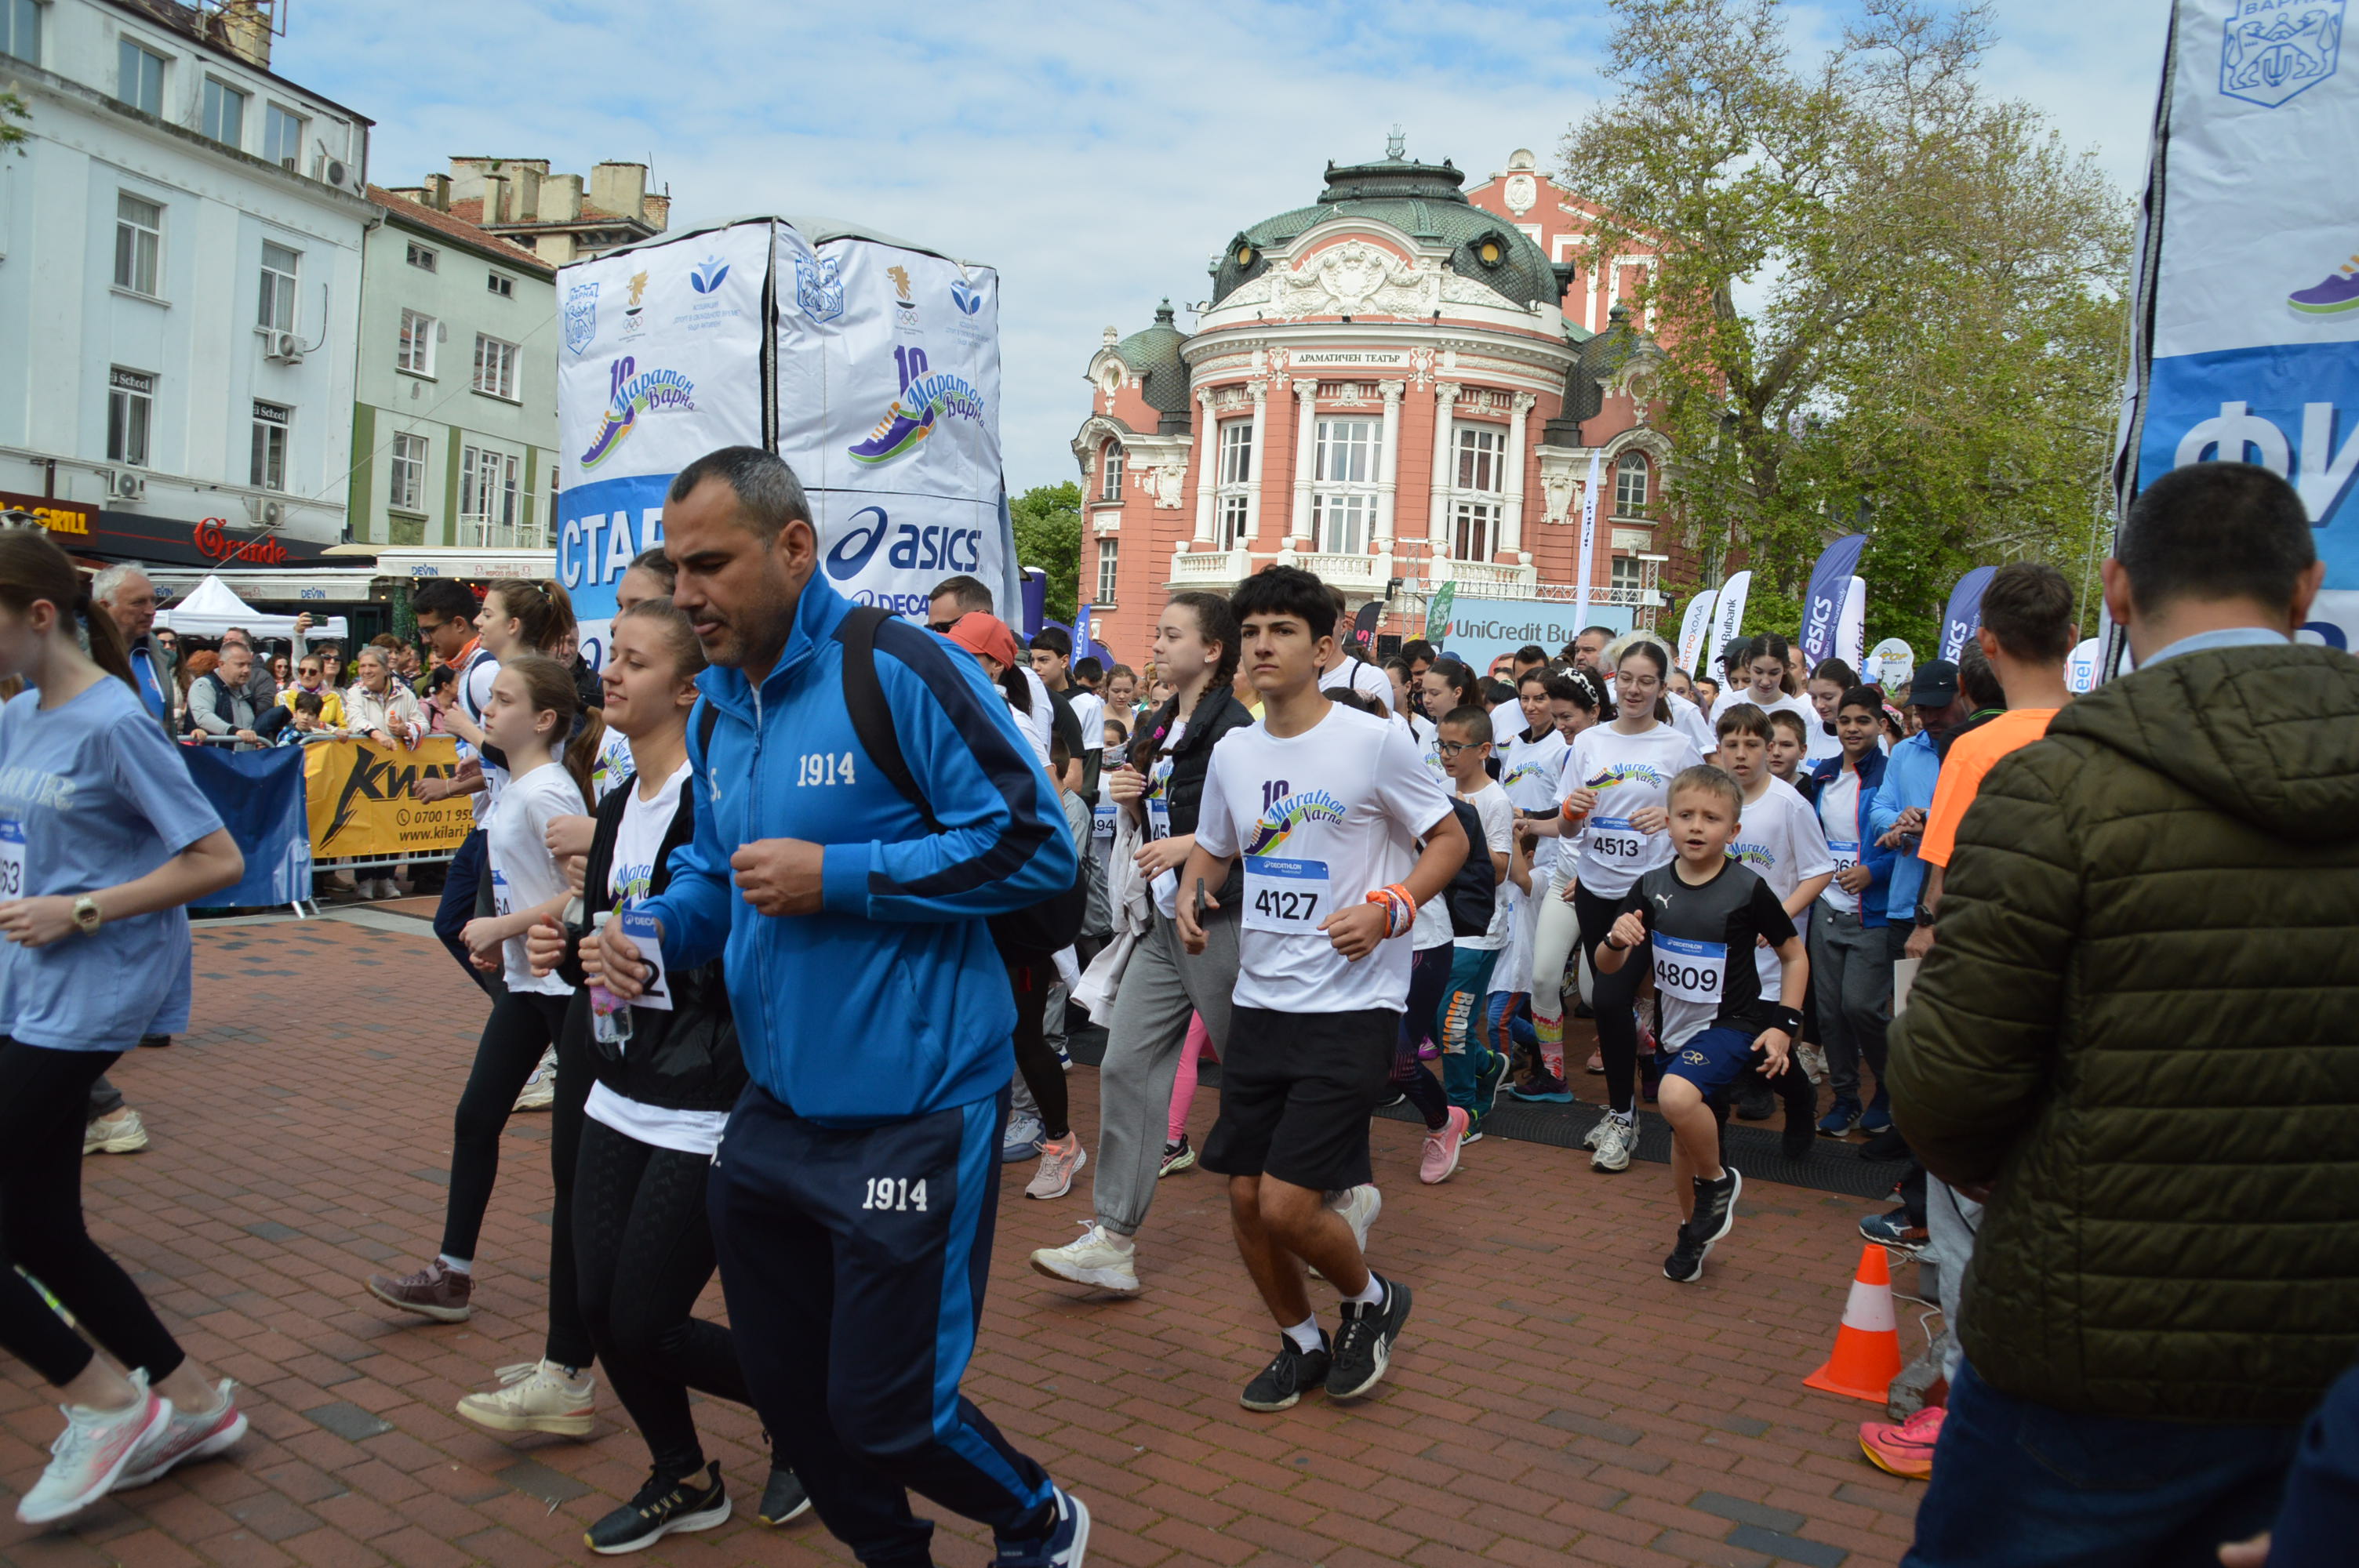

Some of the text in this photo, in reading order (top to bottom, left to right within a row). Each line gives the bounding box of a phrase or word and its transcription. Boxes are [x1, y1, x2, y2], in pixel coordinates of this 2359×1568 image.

[571, 290, 595, 302] ВАРНА
[894, 344, 929, 400] 10
[1298, 354, 1401, 363] ДРАМАТИЧЕН ТЕАТЪР
[610, 355, 635, 406] 10
[614, 368, 695, 418] Маратон
[907, 374, 985, 417] Маратон
[645, 386, 696, 411] Варна
[943, 391, 985, 428] Варна
[32, 506, 89, 535] GRILL
[194, 517, 288, 565] Grande
[412, 564, 438, 576] DEVIN
[301, 586, 325, 600] DEVIN
[1456, 619, 1543, 643] UniCredit
[1721, 597, 1737, 642] Bulbank
[797, 751, 856, 787] 1914
[1612, 762, 1662, 785] Marathon
[1632, 771, 1659, 789] Varna
[1261, 779, 1289, 815] 10
[1268, 789, 1347, 826] Marathon
[414, 808, 442, 823] 0700
[445, 808, 451, 822] 1
[1299, 804, 1343, 826] Varna
[1593, 837, 1639, 857] 4513
[1728, 841, 1776, 864] Marathon
[1747, 852, 1772, 871] Varna
[1255, 889, 1318, 921] 4127
[1656, 959, 1718, 993] 4809
[1442, 990, 1476, 1055] BRONX
[862, 1177, 928, 1212] 1914
